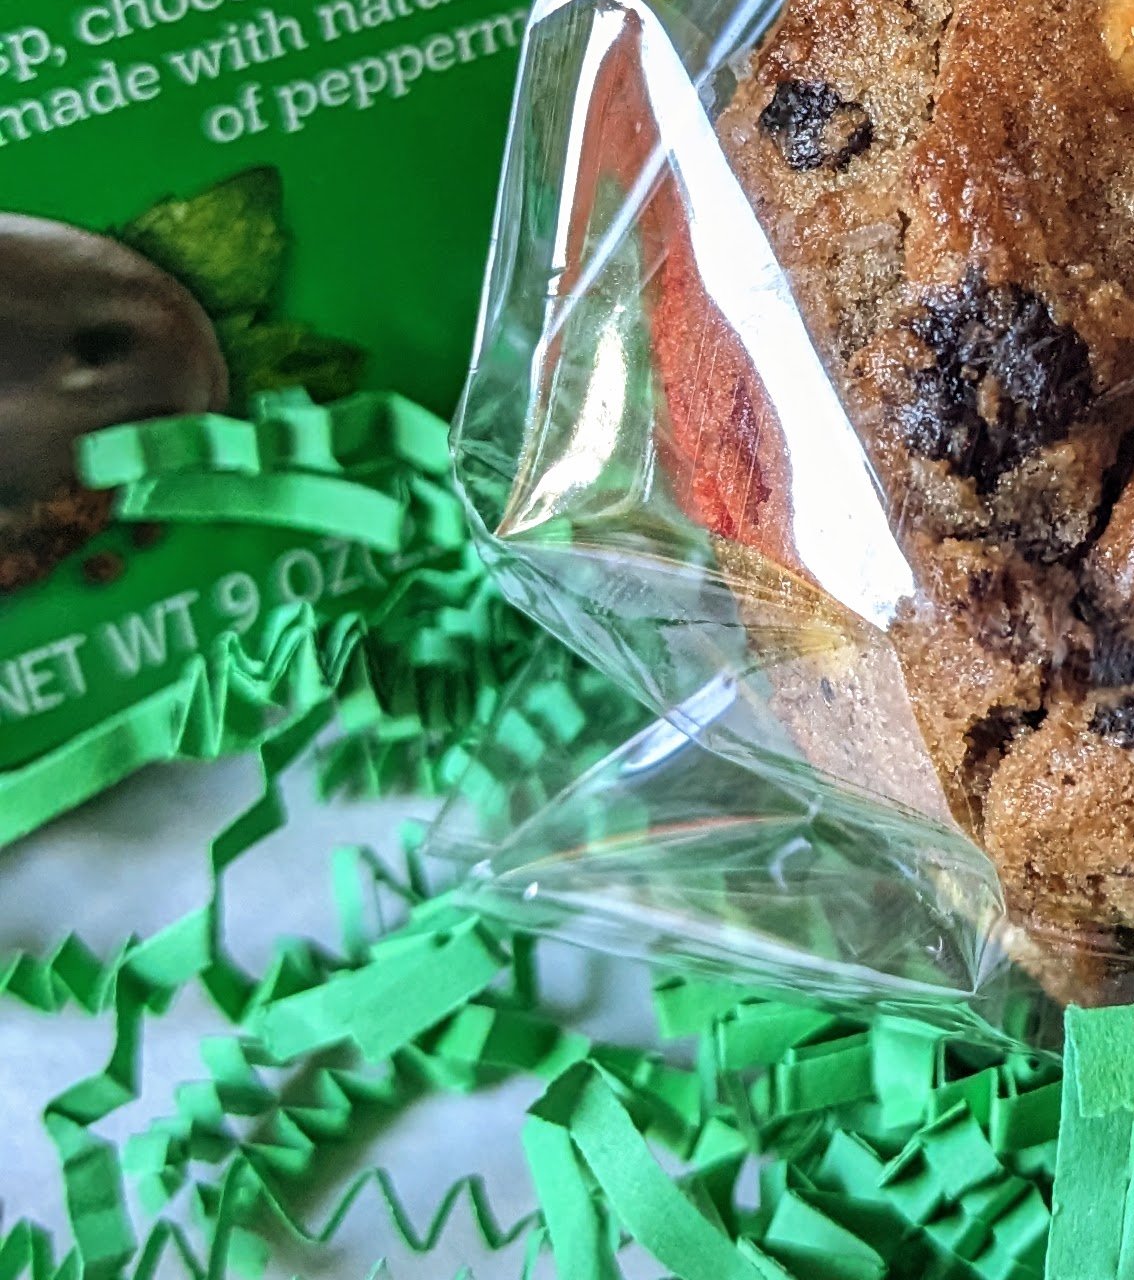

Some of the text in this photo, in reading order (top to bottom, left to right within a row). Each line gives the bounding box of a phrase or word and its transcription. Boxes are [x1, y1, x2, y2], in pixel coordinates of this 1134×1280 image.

[0, 59, 162, 147] made
[170, 8, 309, 86] with
[205, 82, 269, 144] of
[0, 633, 88, 715] NET
[104, 590, 200, 678] WT
[214, 571, 261, 634] 9
